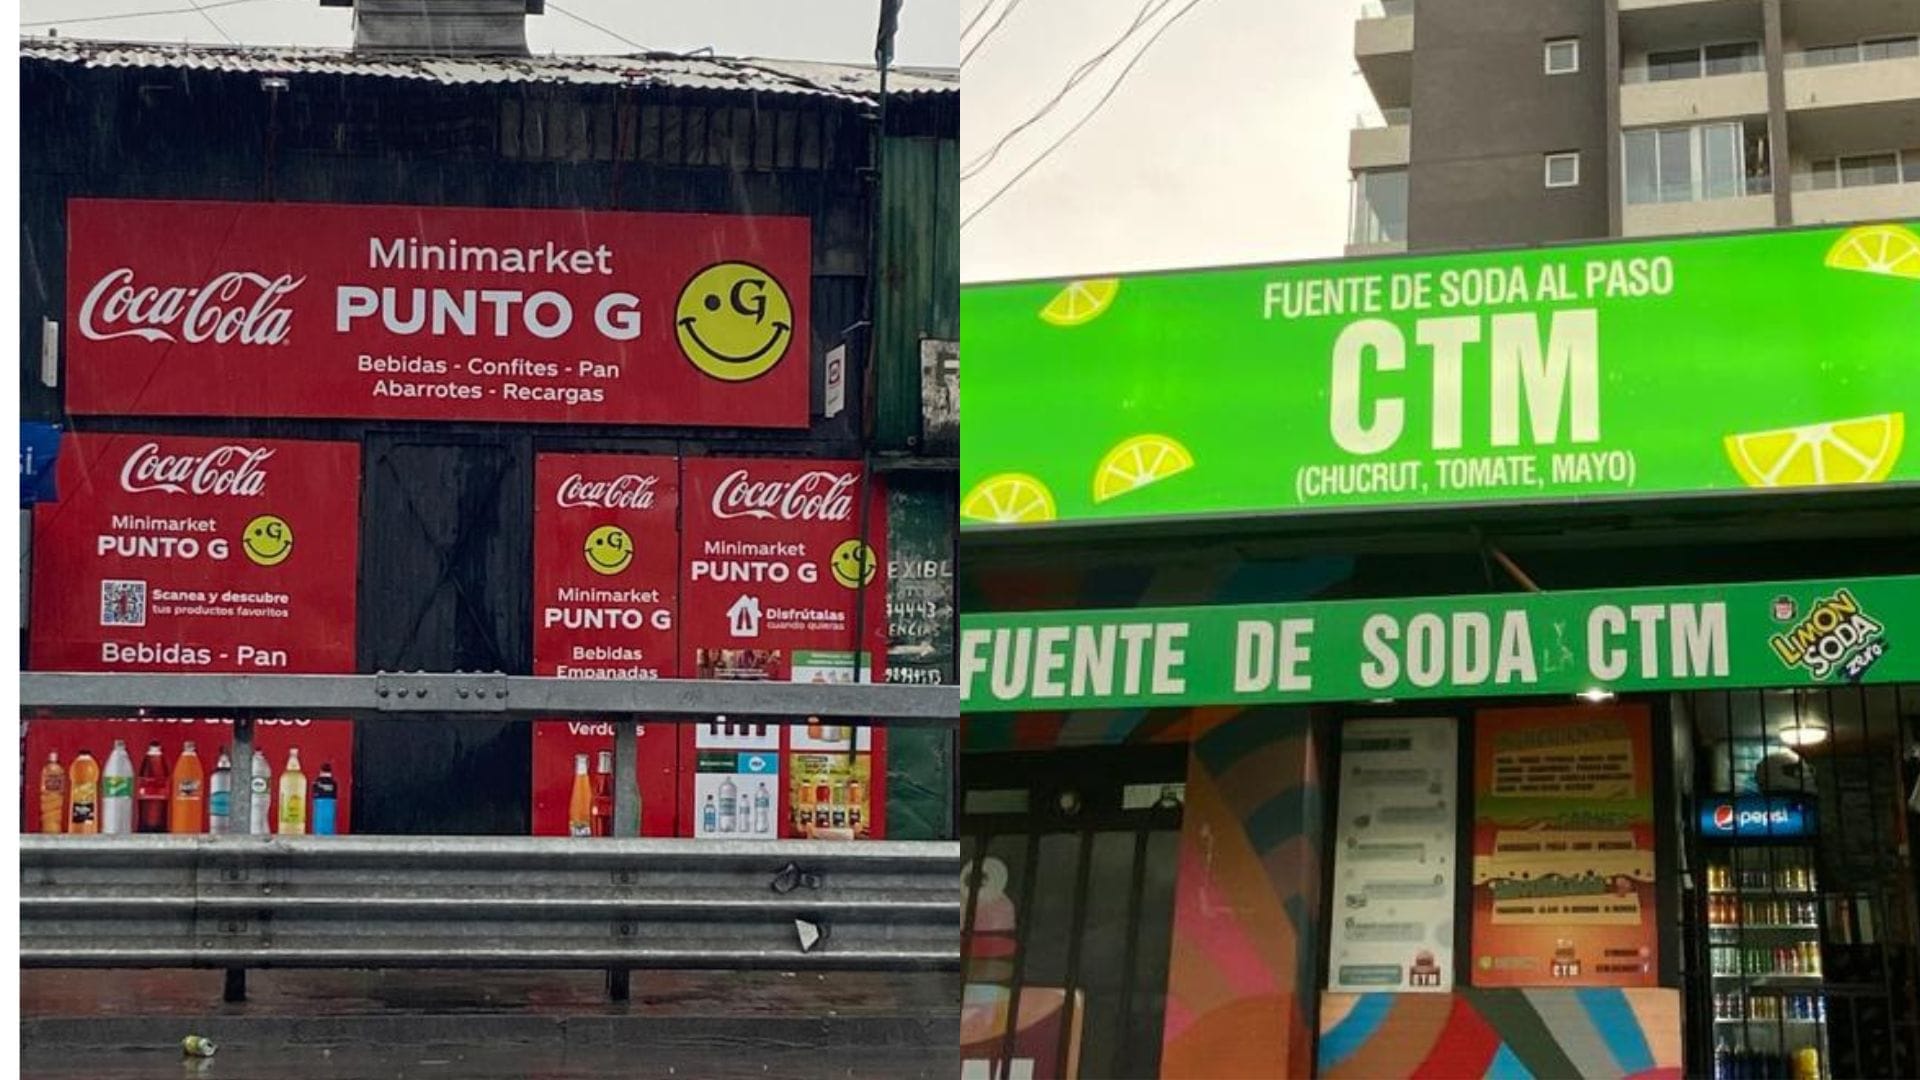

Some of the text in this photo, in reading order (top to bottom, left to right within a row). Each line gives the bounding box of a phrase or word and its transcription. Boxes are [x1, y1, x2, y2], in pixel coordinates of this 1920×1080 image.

[370, 238, 612, 274] Minimarket
[1264, 256, 1673, 319] FUENTE DE SODA AL PASO
[79, 269, 305, 345] Coca-Cola
[337, 286, 640, 340] PUNTO G
[359, 355, 447, 373] Bebidas
[468, 358, 558, 376] Confites
[580, 361, 619, 377] Pan
[373, 380, 482, 398] Abarrotes
[504, 383, 603, 403] Recargas
[1329, 308, 1600, 456] CTM
[121, 443, 274, 496] Coca-Cola
[1296, 451, 1635, 502] (CHUCRUT, TOMATE, MAYO)
[557, 474, 658, 508] Coca-Cola
[712, 470, 860, 520] Coca-Cola
[112, 515, 216, 531] Minimarket
[98, 536, 228, 559] PUNTO G
[705, 541, 805, 556] Minimarket
[692, 561, 817, 582] PUNTO G
[153, 589, 288, 603] Scanea y descubre
[559, 588, 659, 602] Minimarket
[152, 605, 289, 618] tus productos favoritos
[545, 608, 671, 629] PUNTO G
[766, 608, 845, 620] Disfrútalas
[103, 643, 211, 664] Bebidas
[238, 646, 286, 666] Pan
[574, 647, 642, 660] Bebidas
[960, 623, 1188, 699] FUENTE
[1235, 619, 1313, 692] DE
[1361, 610, 1537, 688] SODA
[1588, 602, 1728, 680] CTM
[1803, 614, 1879, 676] SODA
[568, 722, 644, 736] Verdus
